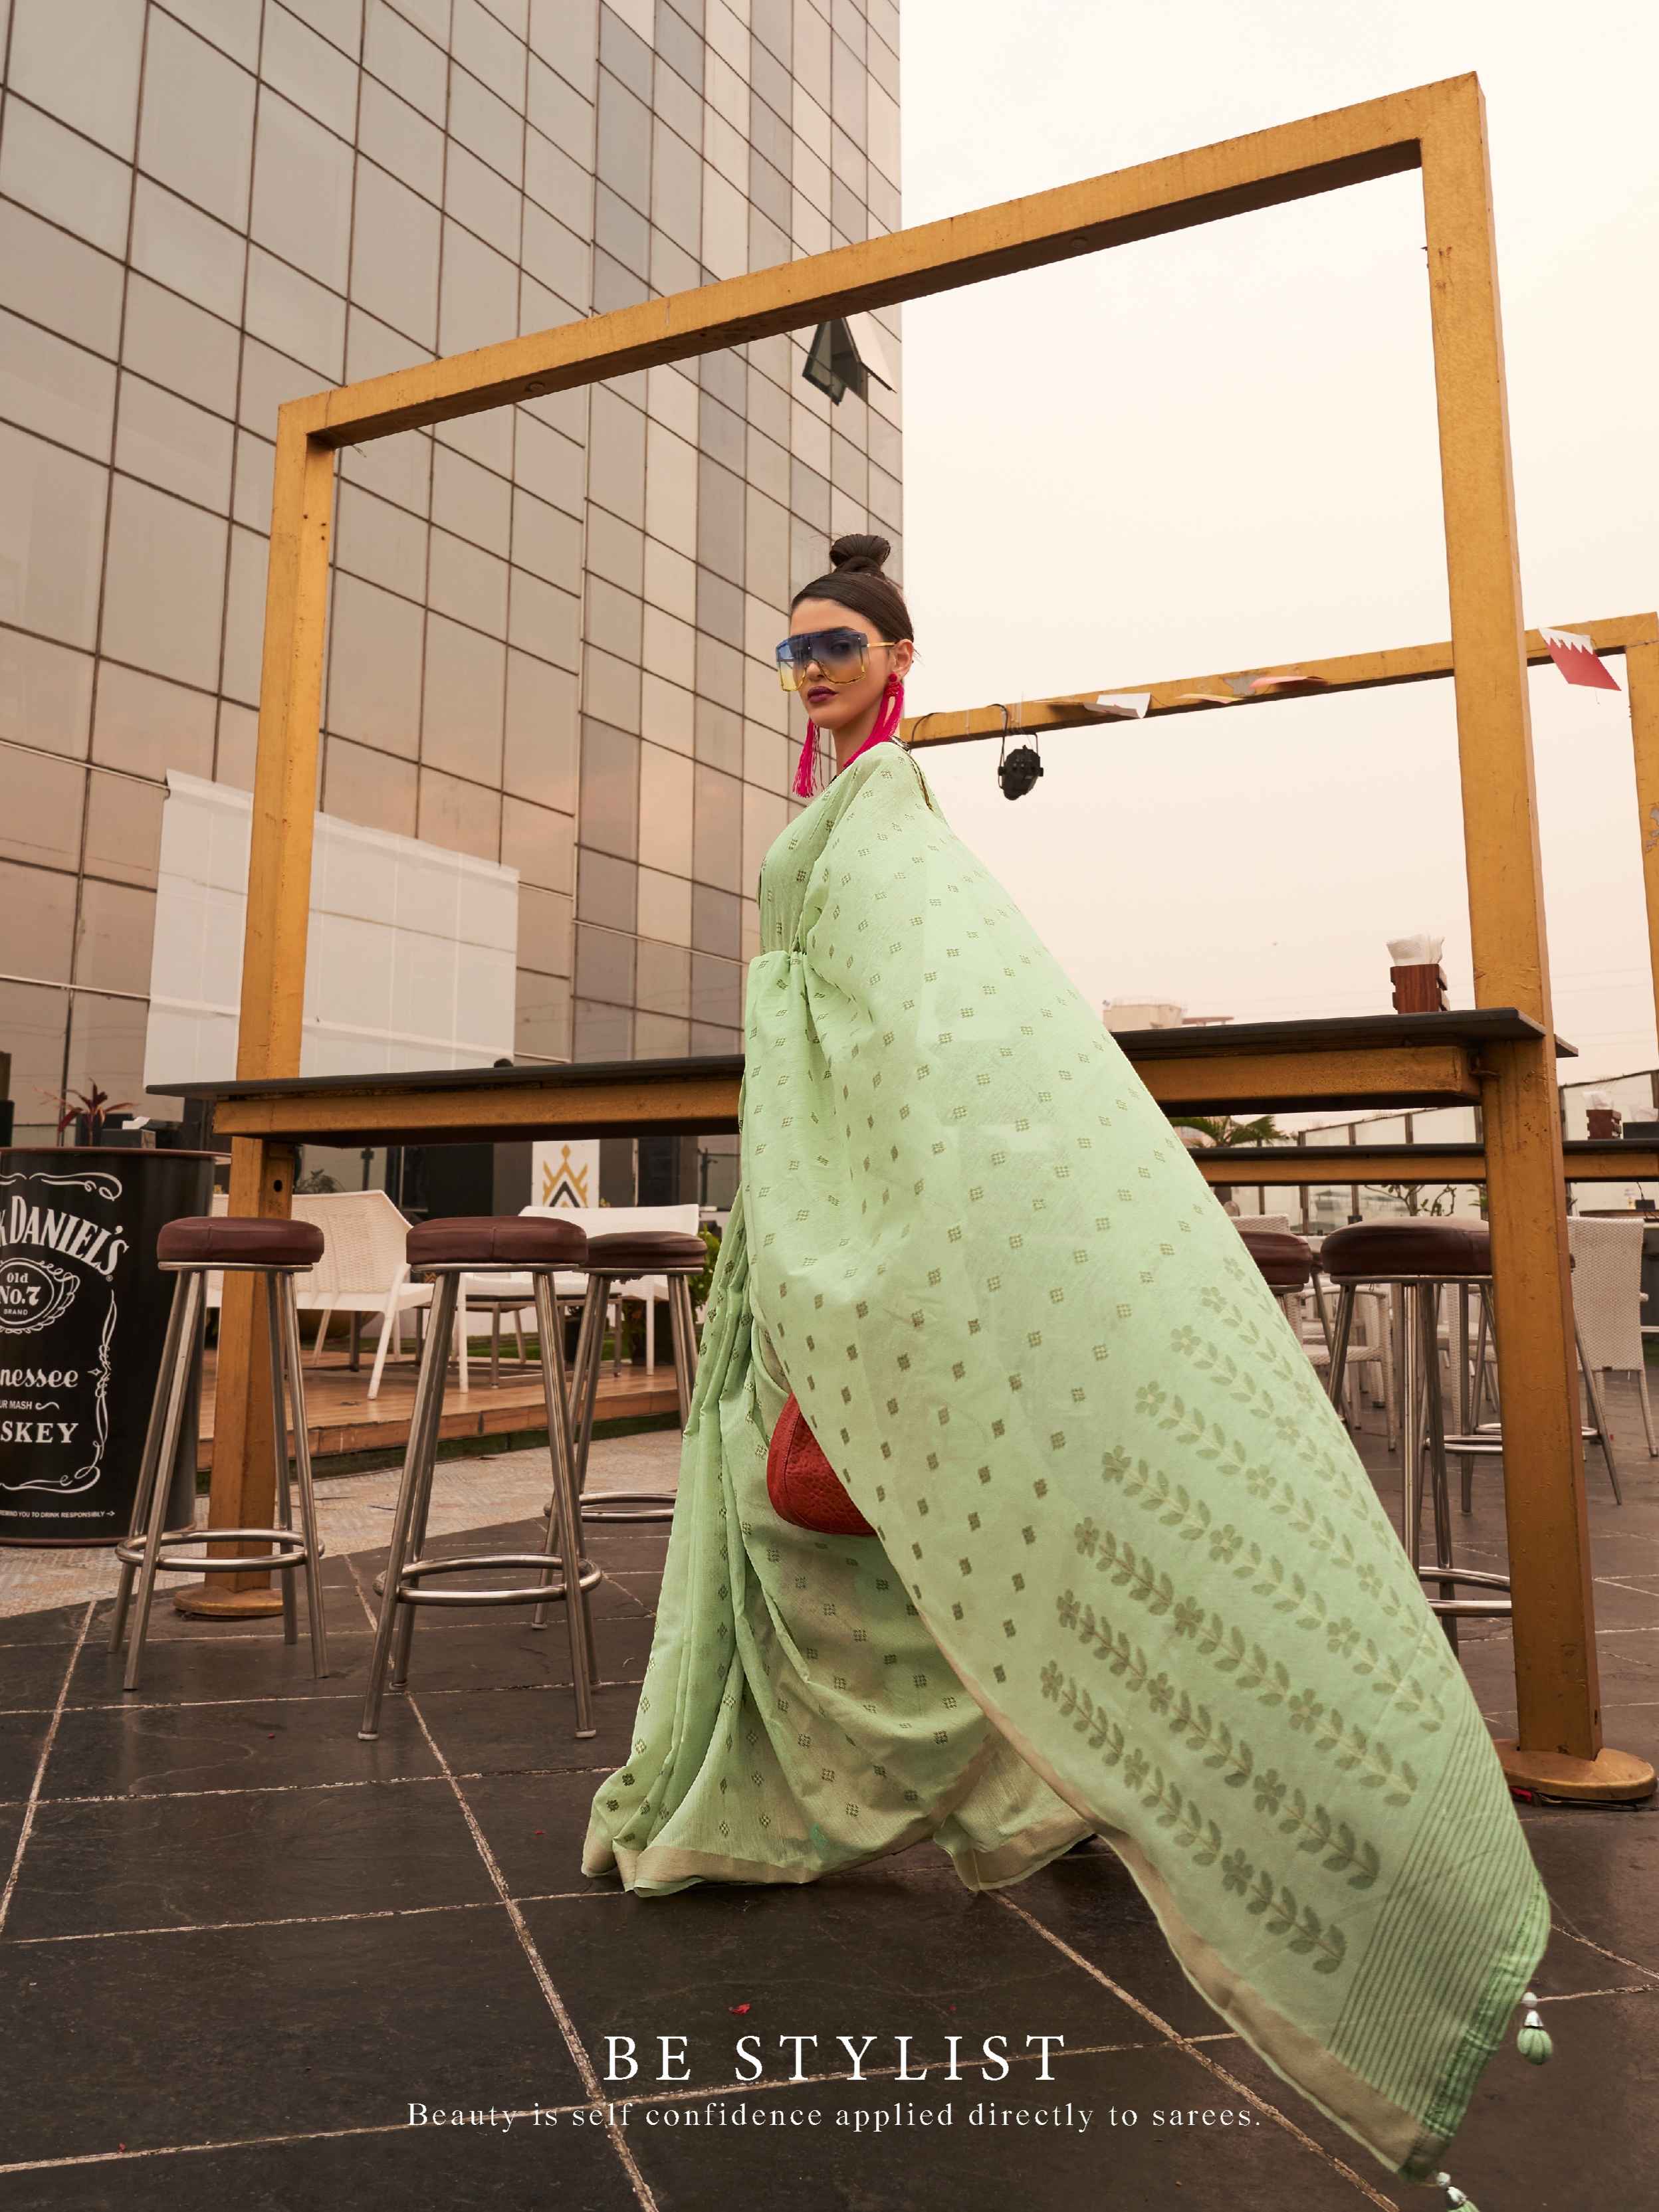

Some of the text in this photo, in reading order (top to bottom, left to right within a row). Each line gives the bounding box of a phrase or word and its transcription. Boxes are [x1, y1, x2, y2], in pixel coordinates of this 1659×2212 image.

[9, 1195, 130, 1275] DANIEL'S
[7, 1272, 29, 1283] Old
[9, 1400, 33, 1409] MASH
